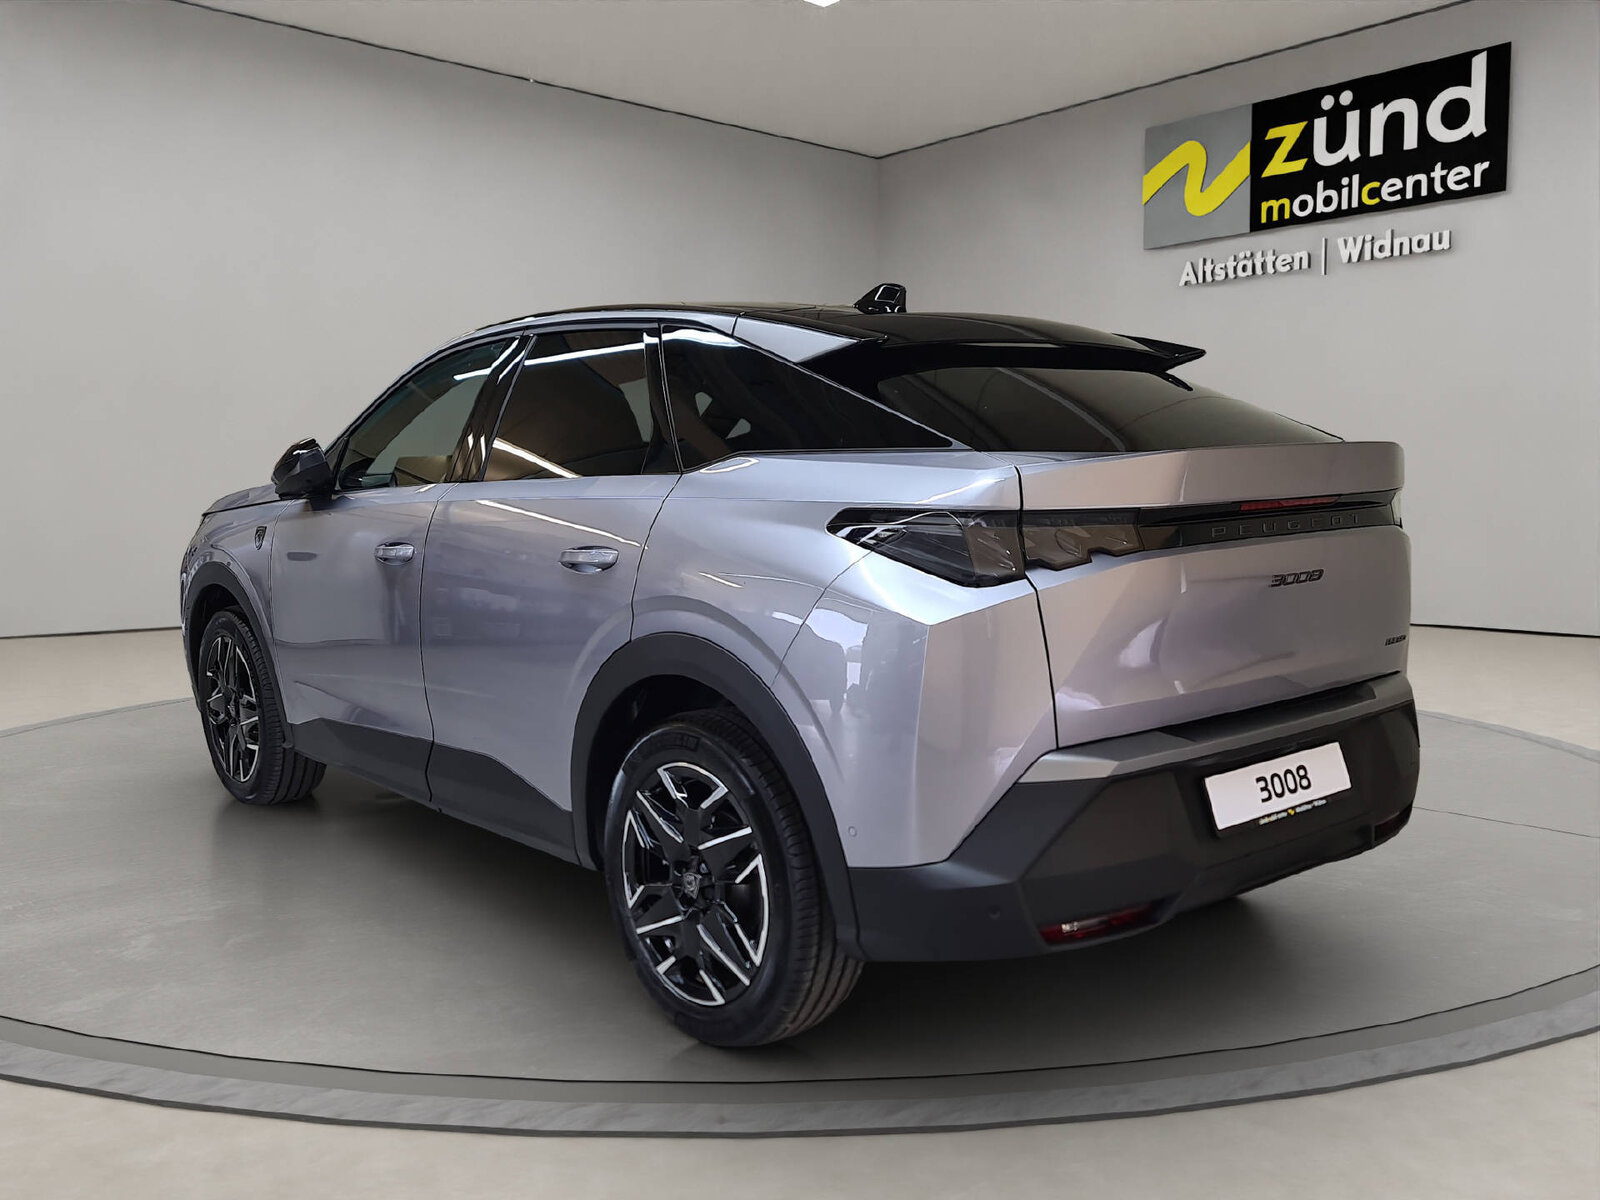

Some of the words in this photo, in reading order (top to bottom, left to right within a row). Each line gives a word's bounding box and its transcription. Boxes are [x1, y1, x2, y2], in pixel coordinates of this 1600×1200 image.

[1261, 51, 1487, 177] zünd
[1261, 161, 1490, 223] mobilcenter
[1179, 248, 1310, 286] Altstätten
[1337, 228, 1452, 264] Widnau
[1269, 568, 1324, 588] 3008
[1255, 764, 1312, 803] 3008
